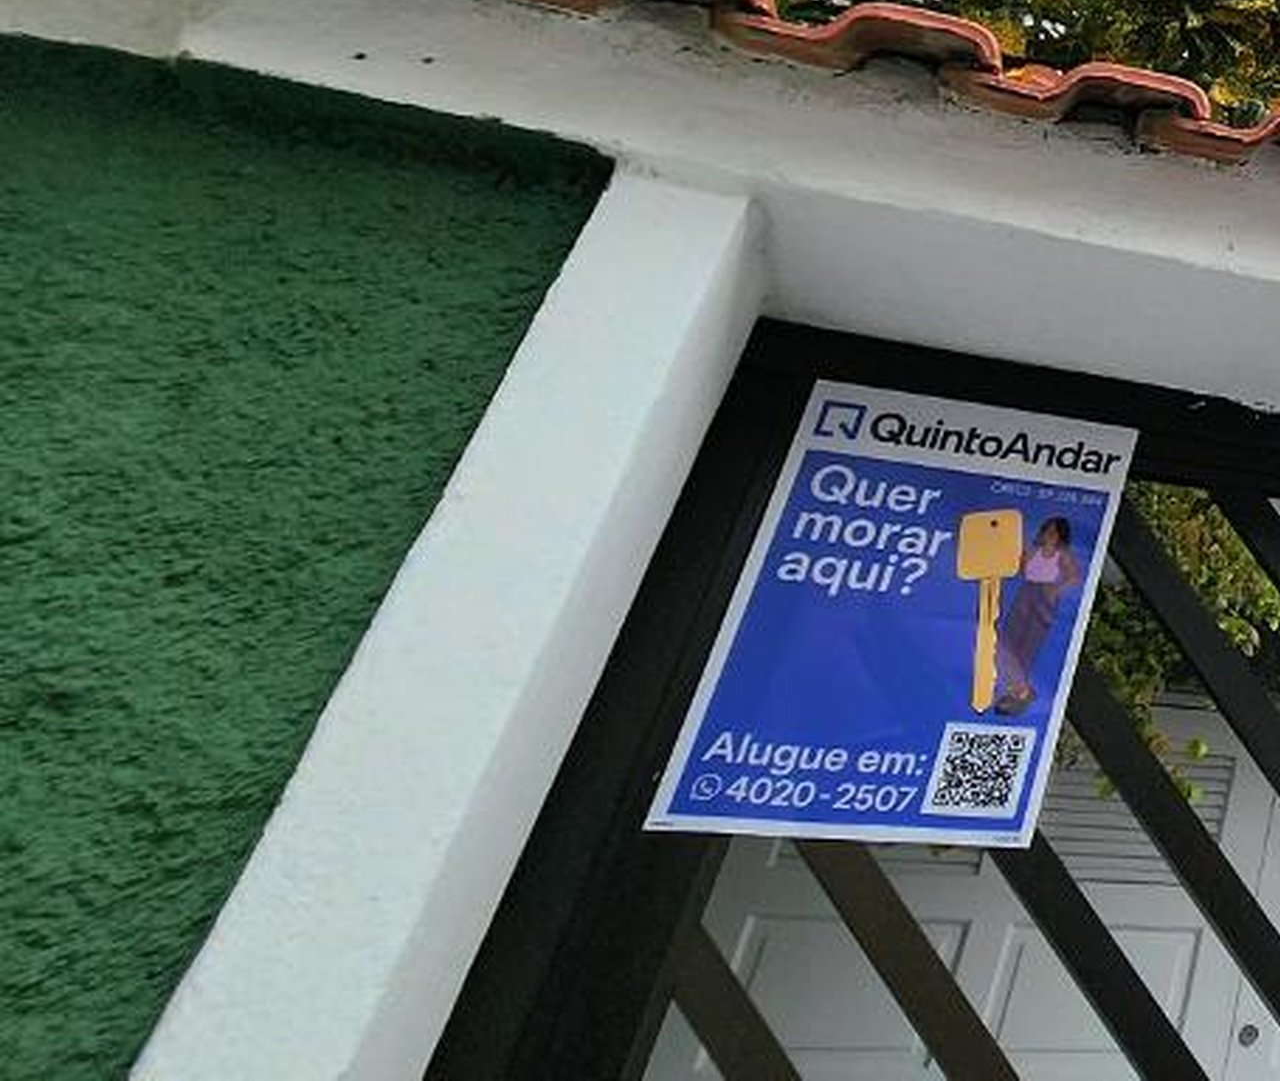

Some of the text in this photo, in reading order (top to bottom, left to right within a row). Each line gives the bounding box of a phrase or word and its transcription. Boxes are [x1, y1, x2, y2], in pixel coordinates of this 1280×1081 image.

[870, 412, 1122, 474] QuintoAndar
[810, 464, 942, 514] Quer
[792, 511, 953, 557] morar
[776, 552, 928, 597] aqui?
[702, 731, 928, 776] Alugue em:
